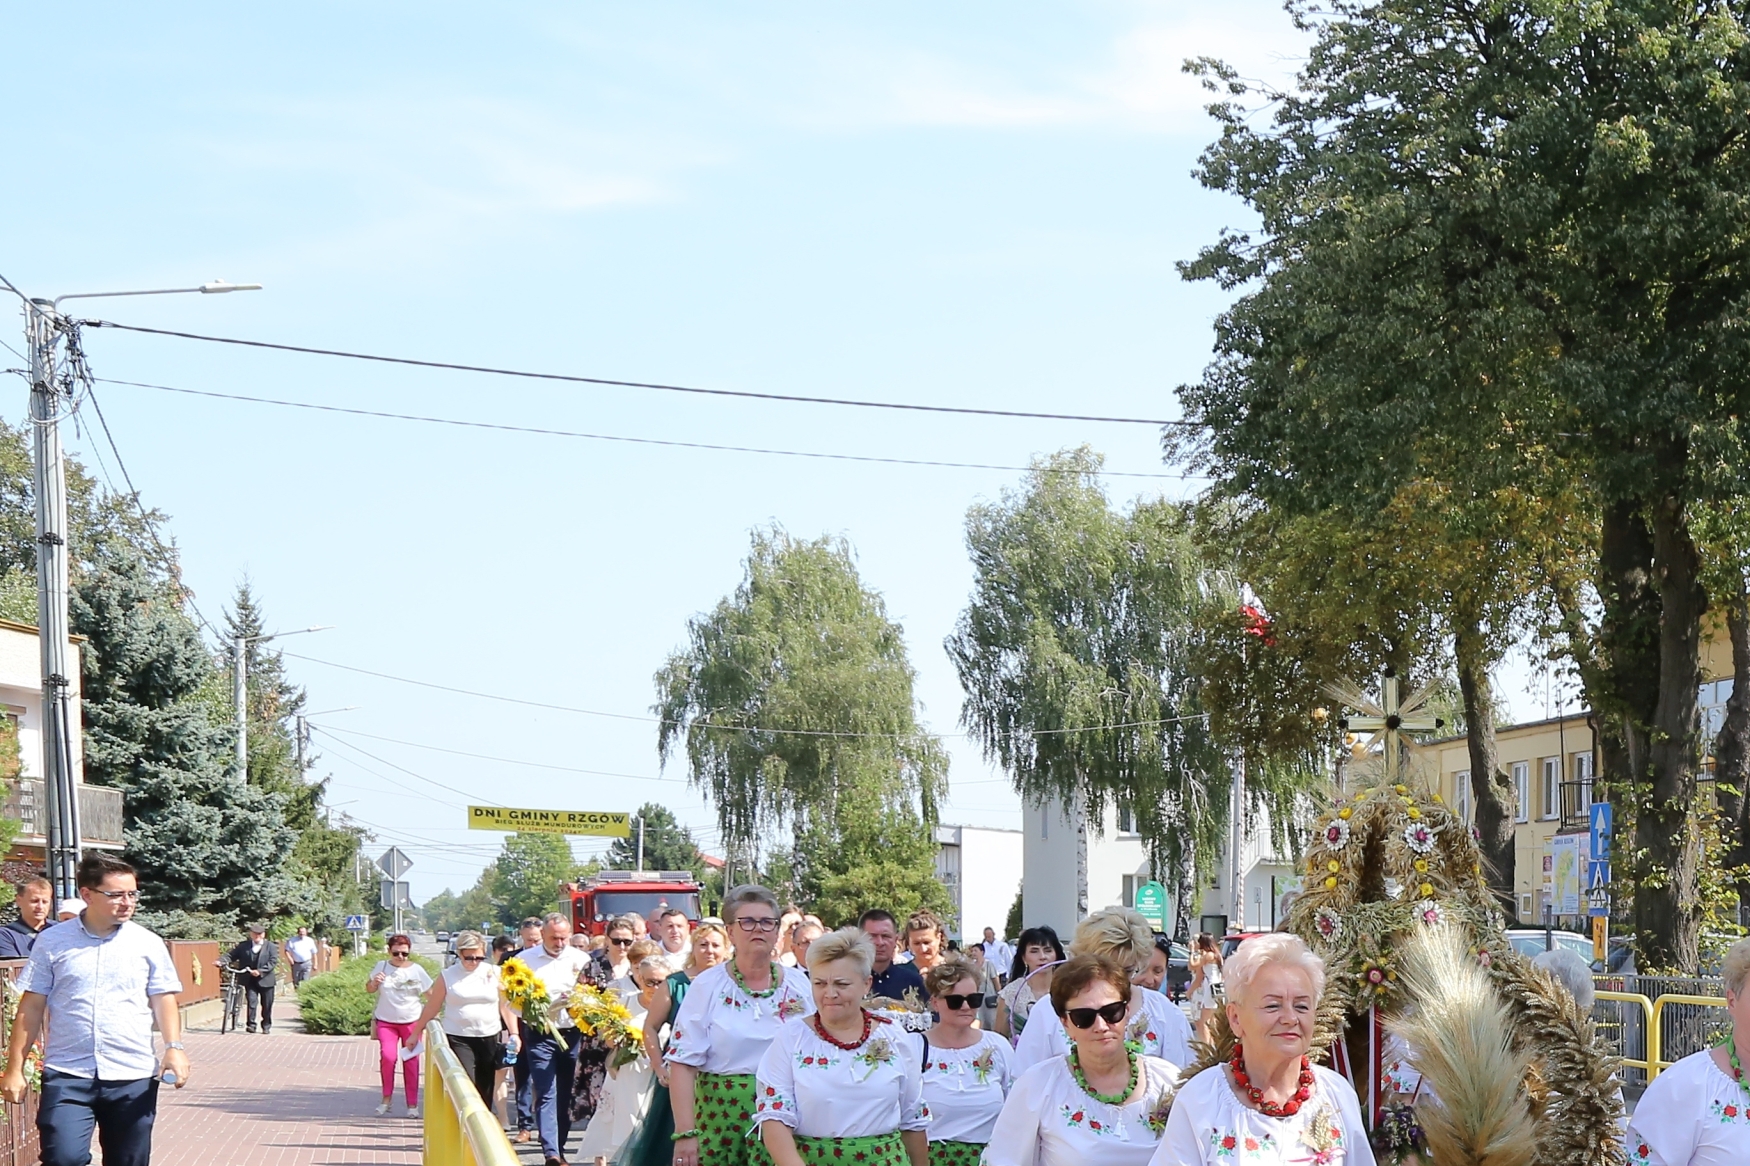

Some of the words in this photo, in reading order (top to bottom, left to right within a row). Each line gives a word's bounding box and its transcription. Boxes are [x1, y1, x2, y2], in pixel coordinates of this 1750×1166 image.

[474, 808, 501, 818] DNI
[509, 810, 560, 821] GMINY
[568, 813, 625, 823] RZGÓW
[544, 822, 606, 830] MUNDUROWYCH
